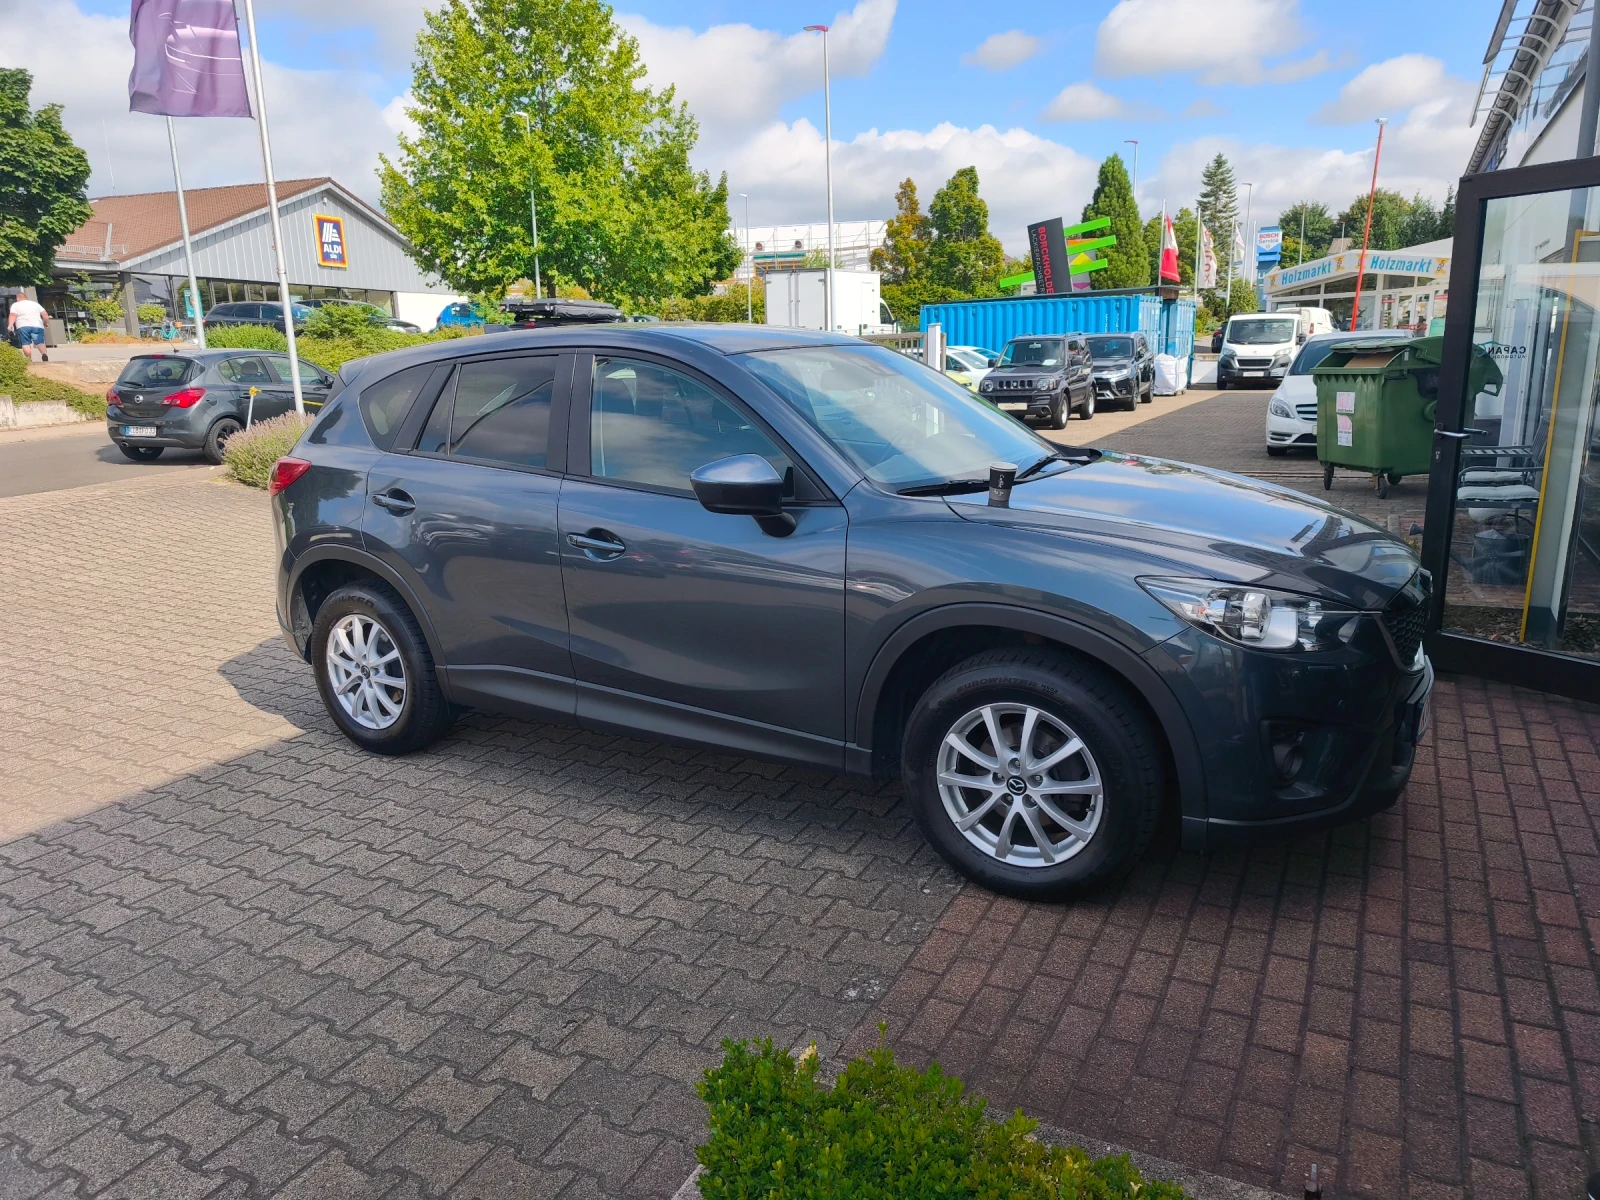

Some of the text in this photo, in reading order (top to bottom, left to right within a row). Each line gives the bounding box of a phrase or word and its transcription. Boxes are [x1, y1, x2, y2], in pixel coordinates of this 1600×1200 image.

[323, 243, 342, 254] ALDI
[1282, 260, 1332, 285] Holzmarkt
[1370, 256, 1432, 273] Holzmarkt
[956, 677, 1037, 692] EUROWINTER
